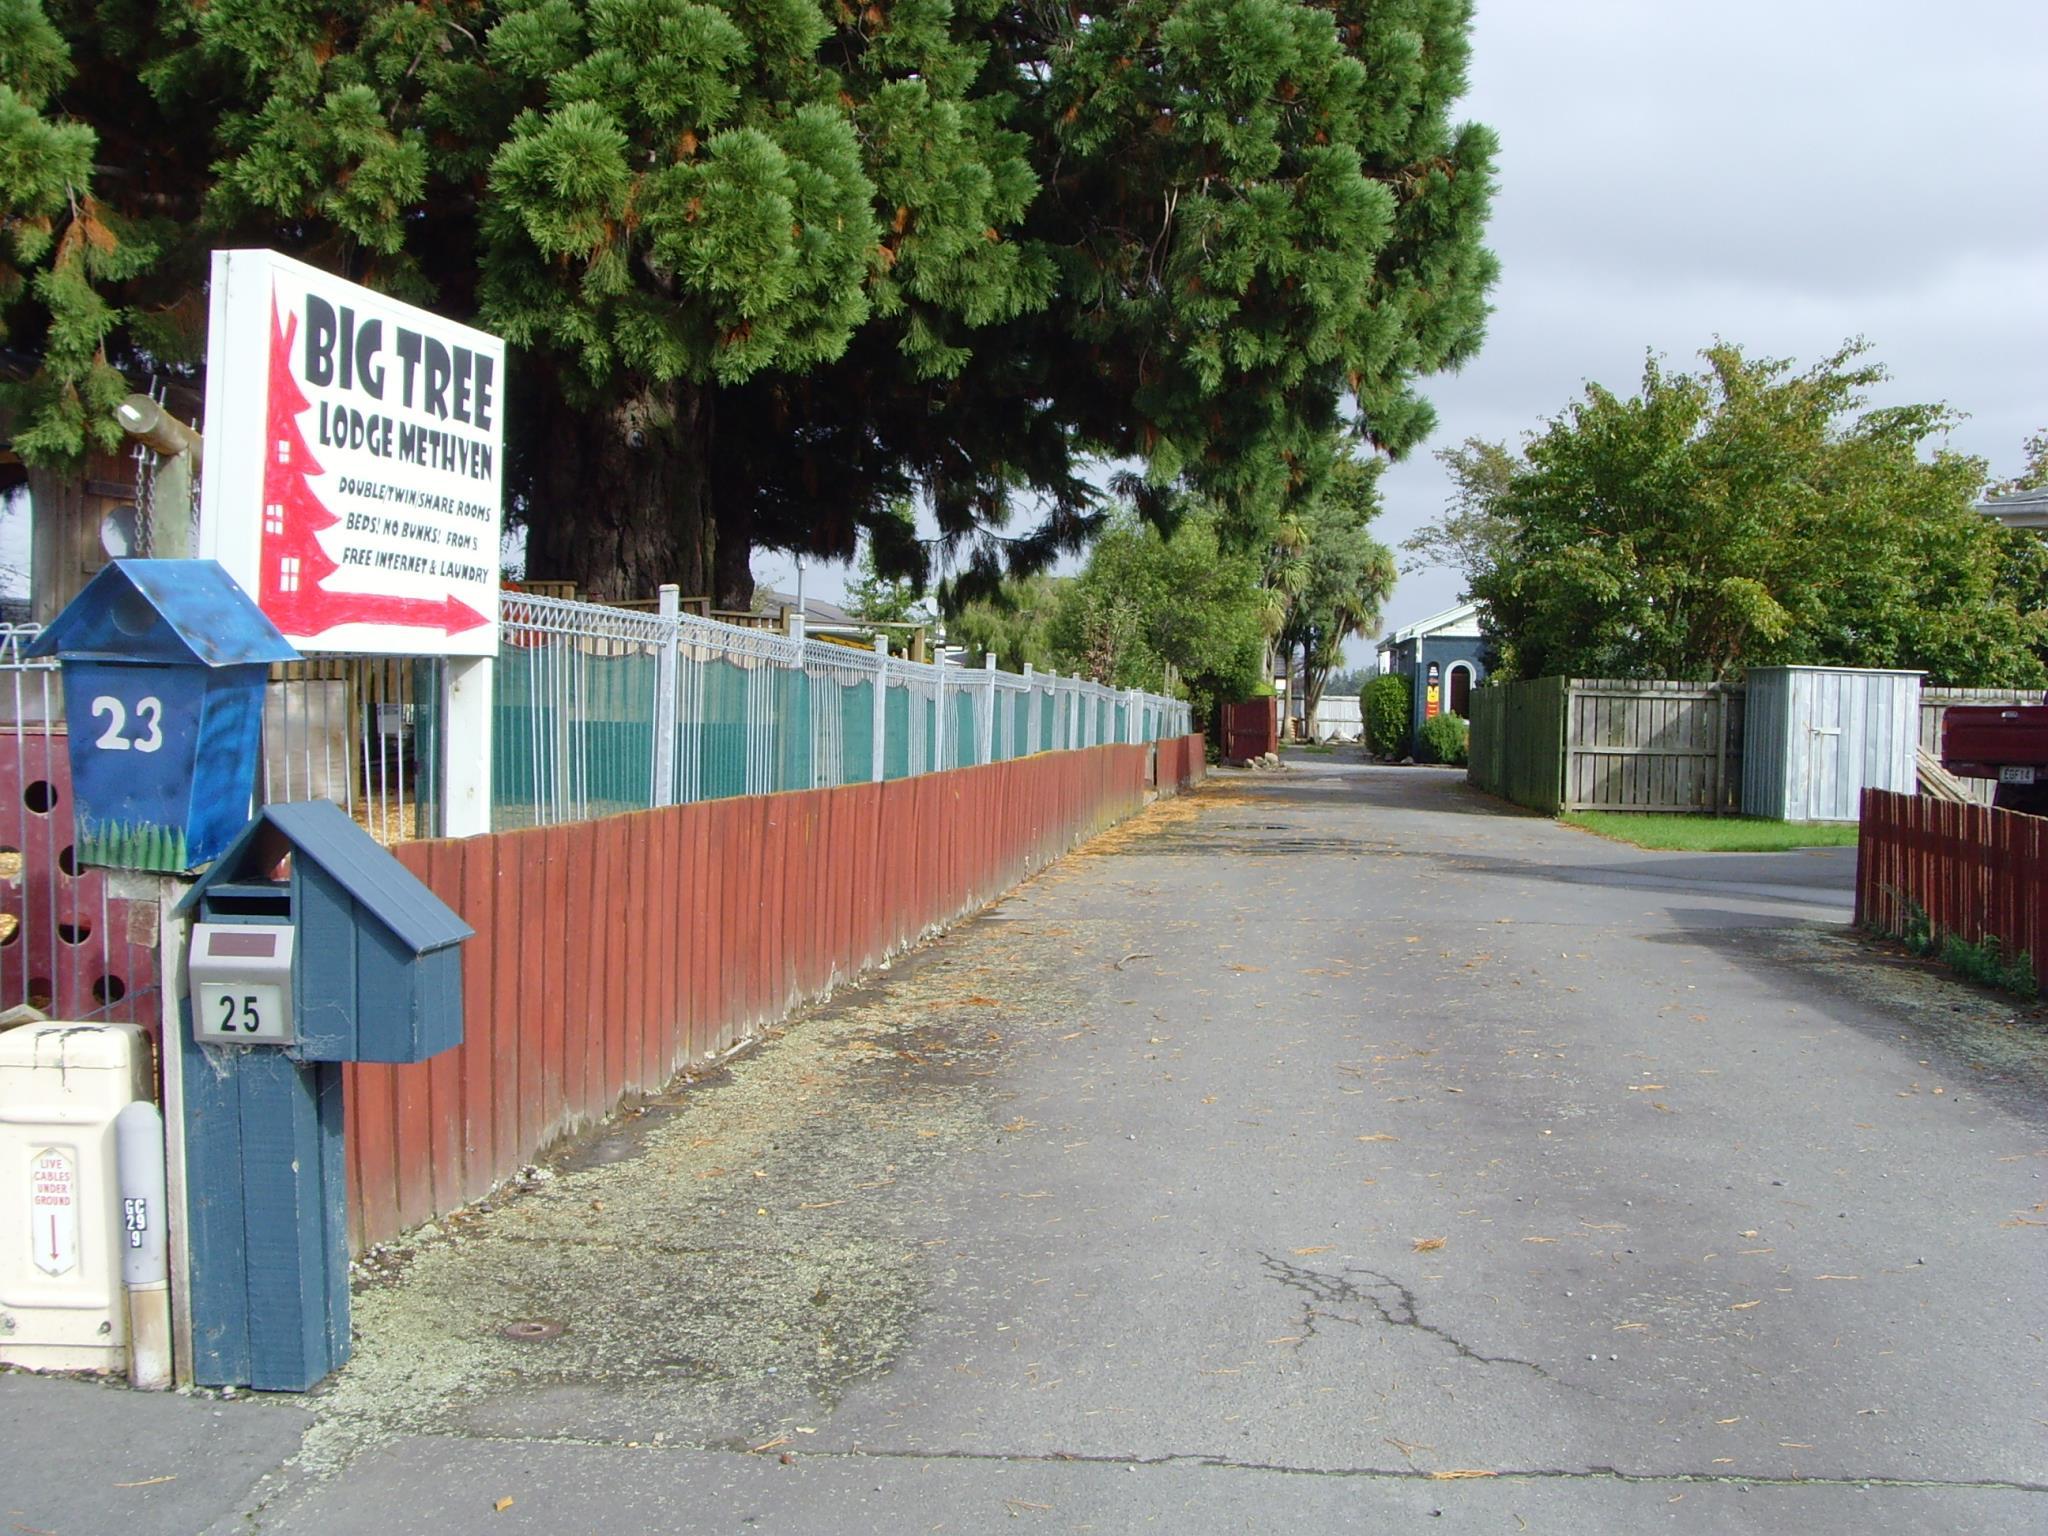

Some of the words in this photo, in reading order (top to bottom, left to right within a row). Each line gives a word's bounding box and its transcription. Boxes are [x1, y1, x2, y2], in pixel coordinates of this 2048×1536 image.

[305, 293, 385, 401] BIG
[396, 326, 494, 432] TREE
[319, 400, 393, 458] LODGE
[399, 421, 492, 482] METHVEN
[456, 501, 492, 523] ROOMS
[346, 512, 381, 534] BEDS!
[383, 518, 399, 537] NO
[401, 522, 441, 545] BUNKS!
[445, 531, 472, 549] FROM
[342, 547, 374, 567] FREE
[375, 551, 428, 575] INTERNET
[429, 559, 437, 576] &
[440, 560, 490, 585] LAUNDRY
[91, 695, 163, 753] 23
[219, 995, 260, 1033] 25
[40, 1159, 63, 1169] LIVE
[34, 1171, 71, 1182] CABLES
[37, 1183, 68, 1194] UNDER
[34, 1195, 71, 1206] GROUND
[126, 1214, 146, 1230] 29
[131, 1230, 142, 1247] 9
